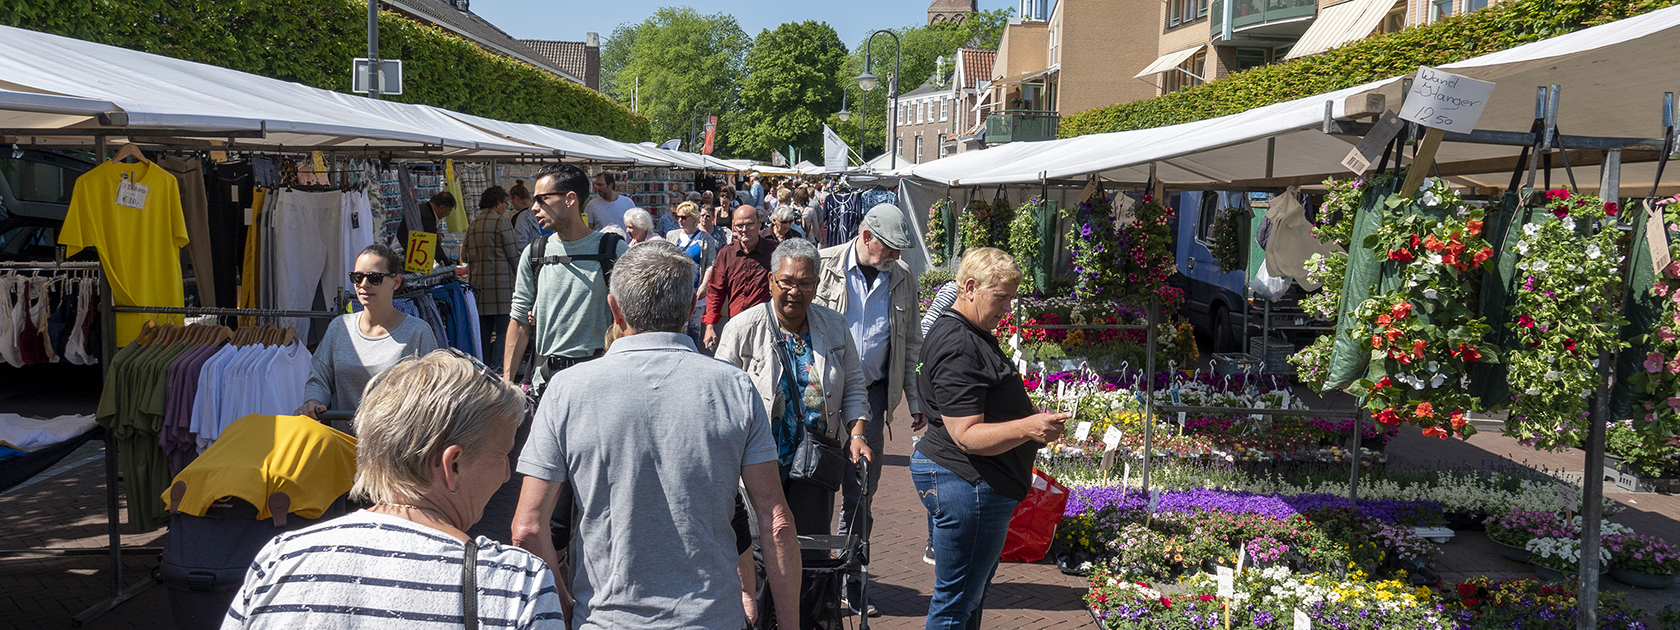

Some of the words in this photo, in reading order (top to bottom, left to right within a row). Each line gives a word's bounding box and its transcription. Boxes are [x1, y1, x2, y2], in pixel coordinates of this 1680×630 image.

[1421, 69, 1459, 89] Wand
[1414, 82, 1480, 110] Hanger
[1414, 106, 1453, 125] 12.50
